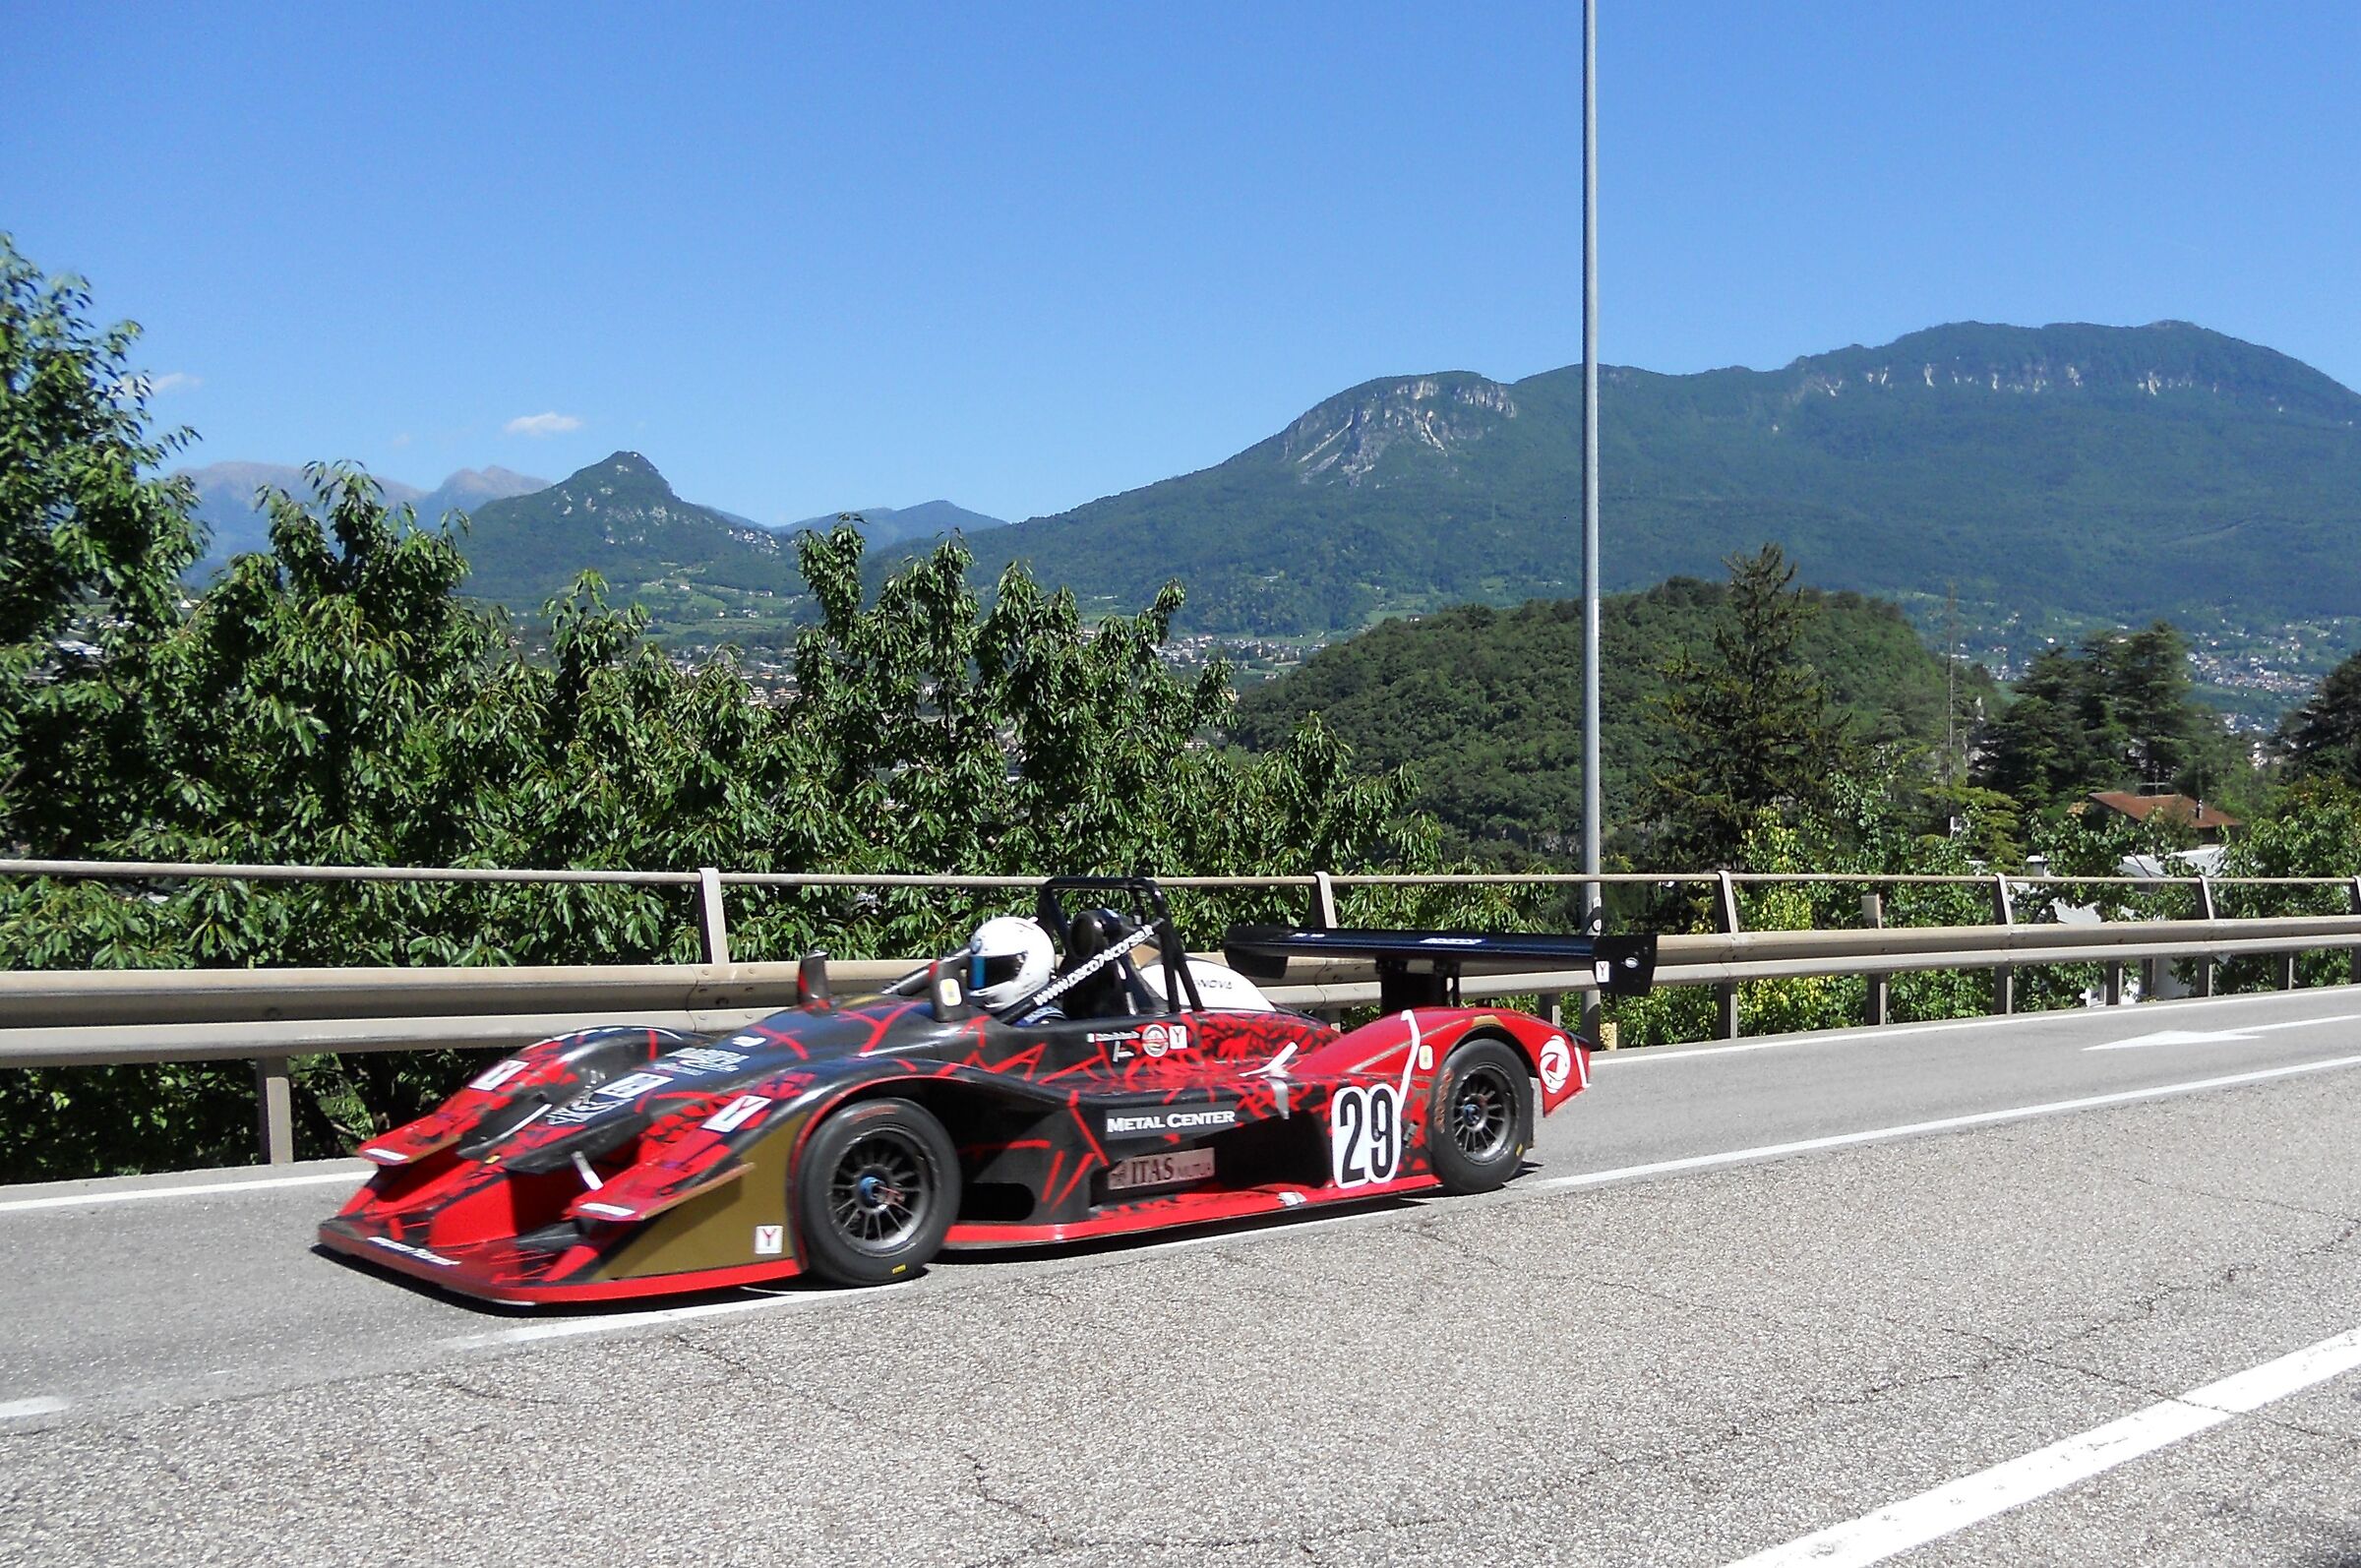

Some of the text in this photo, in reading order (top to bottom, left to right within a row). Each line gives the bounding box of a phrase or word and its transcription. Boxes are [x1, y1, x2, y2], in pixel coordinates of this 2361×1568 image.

[1107, 1110, 1237, 1133] METAL CENTER
[1339, 1087, 1394, 1183] 29
[1131, 1157, 1175, 1184] ITAS
